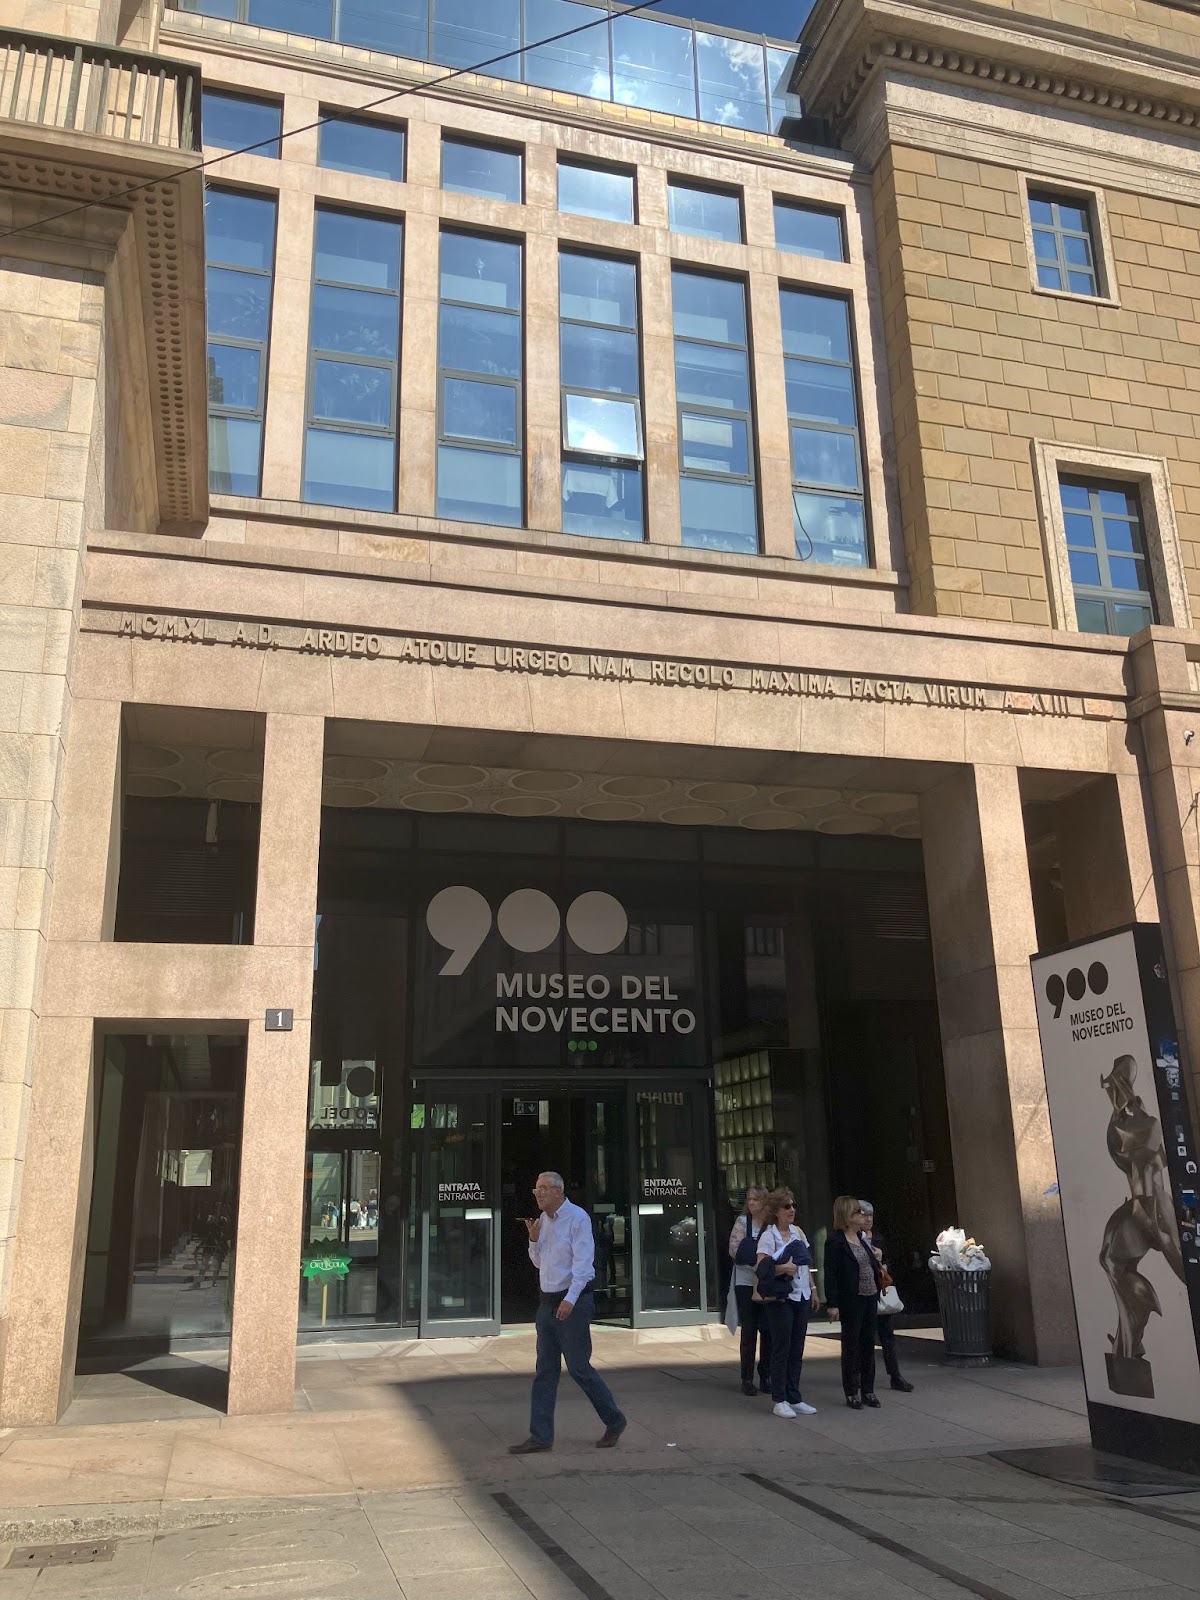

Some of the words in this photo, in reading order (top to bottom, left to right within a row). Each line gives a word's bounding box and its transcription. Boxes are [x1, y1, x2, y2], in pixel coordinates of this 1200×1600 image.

[119, 611, 218, 642] MCMXL
[301, 627, 383, 656] ARDEO
[400, 637, 477, 665] ATQUE
[494, 646, 573, 673] URGEO
[588, 655, 635, 680] NAM
[650, 660, 736, 689] RECOLO
[750, 669, 836, 696] MAXIMA
[850, 677, 914, 701] FACTA
[924, 683, 987, 708] VIRUM
[426, 885, 628, 976] 900
[496, 972, 611, 1000] MUSEO
[621, 975, 678, 1001] DEL
[1045, 961, 1109, 1020] 900
[276, 1011, 283, 1027] 1
[495, 1006, 696, 1034] NOVECENTO
[1070, 1007, 1104, 1026] MUSEO
[1106, 1002, 1126, 1018] DEL
[1071, 1017, 1134, 1042] NOVECENTO
[439, 1182, 481, 1192] ENTRATA
[644, 1178, 683, 1187] ENTRATA
[644, 1186, 688, 1197] ENTRANCE
[438, 1191, 486, 1202] ENTRANCE
